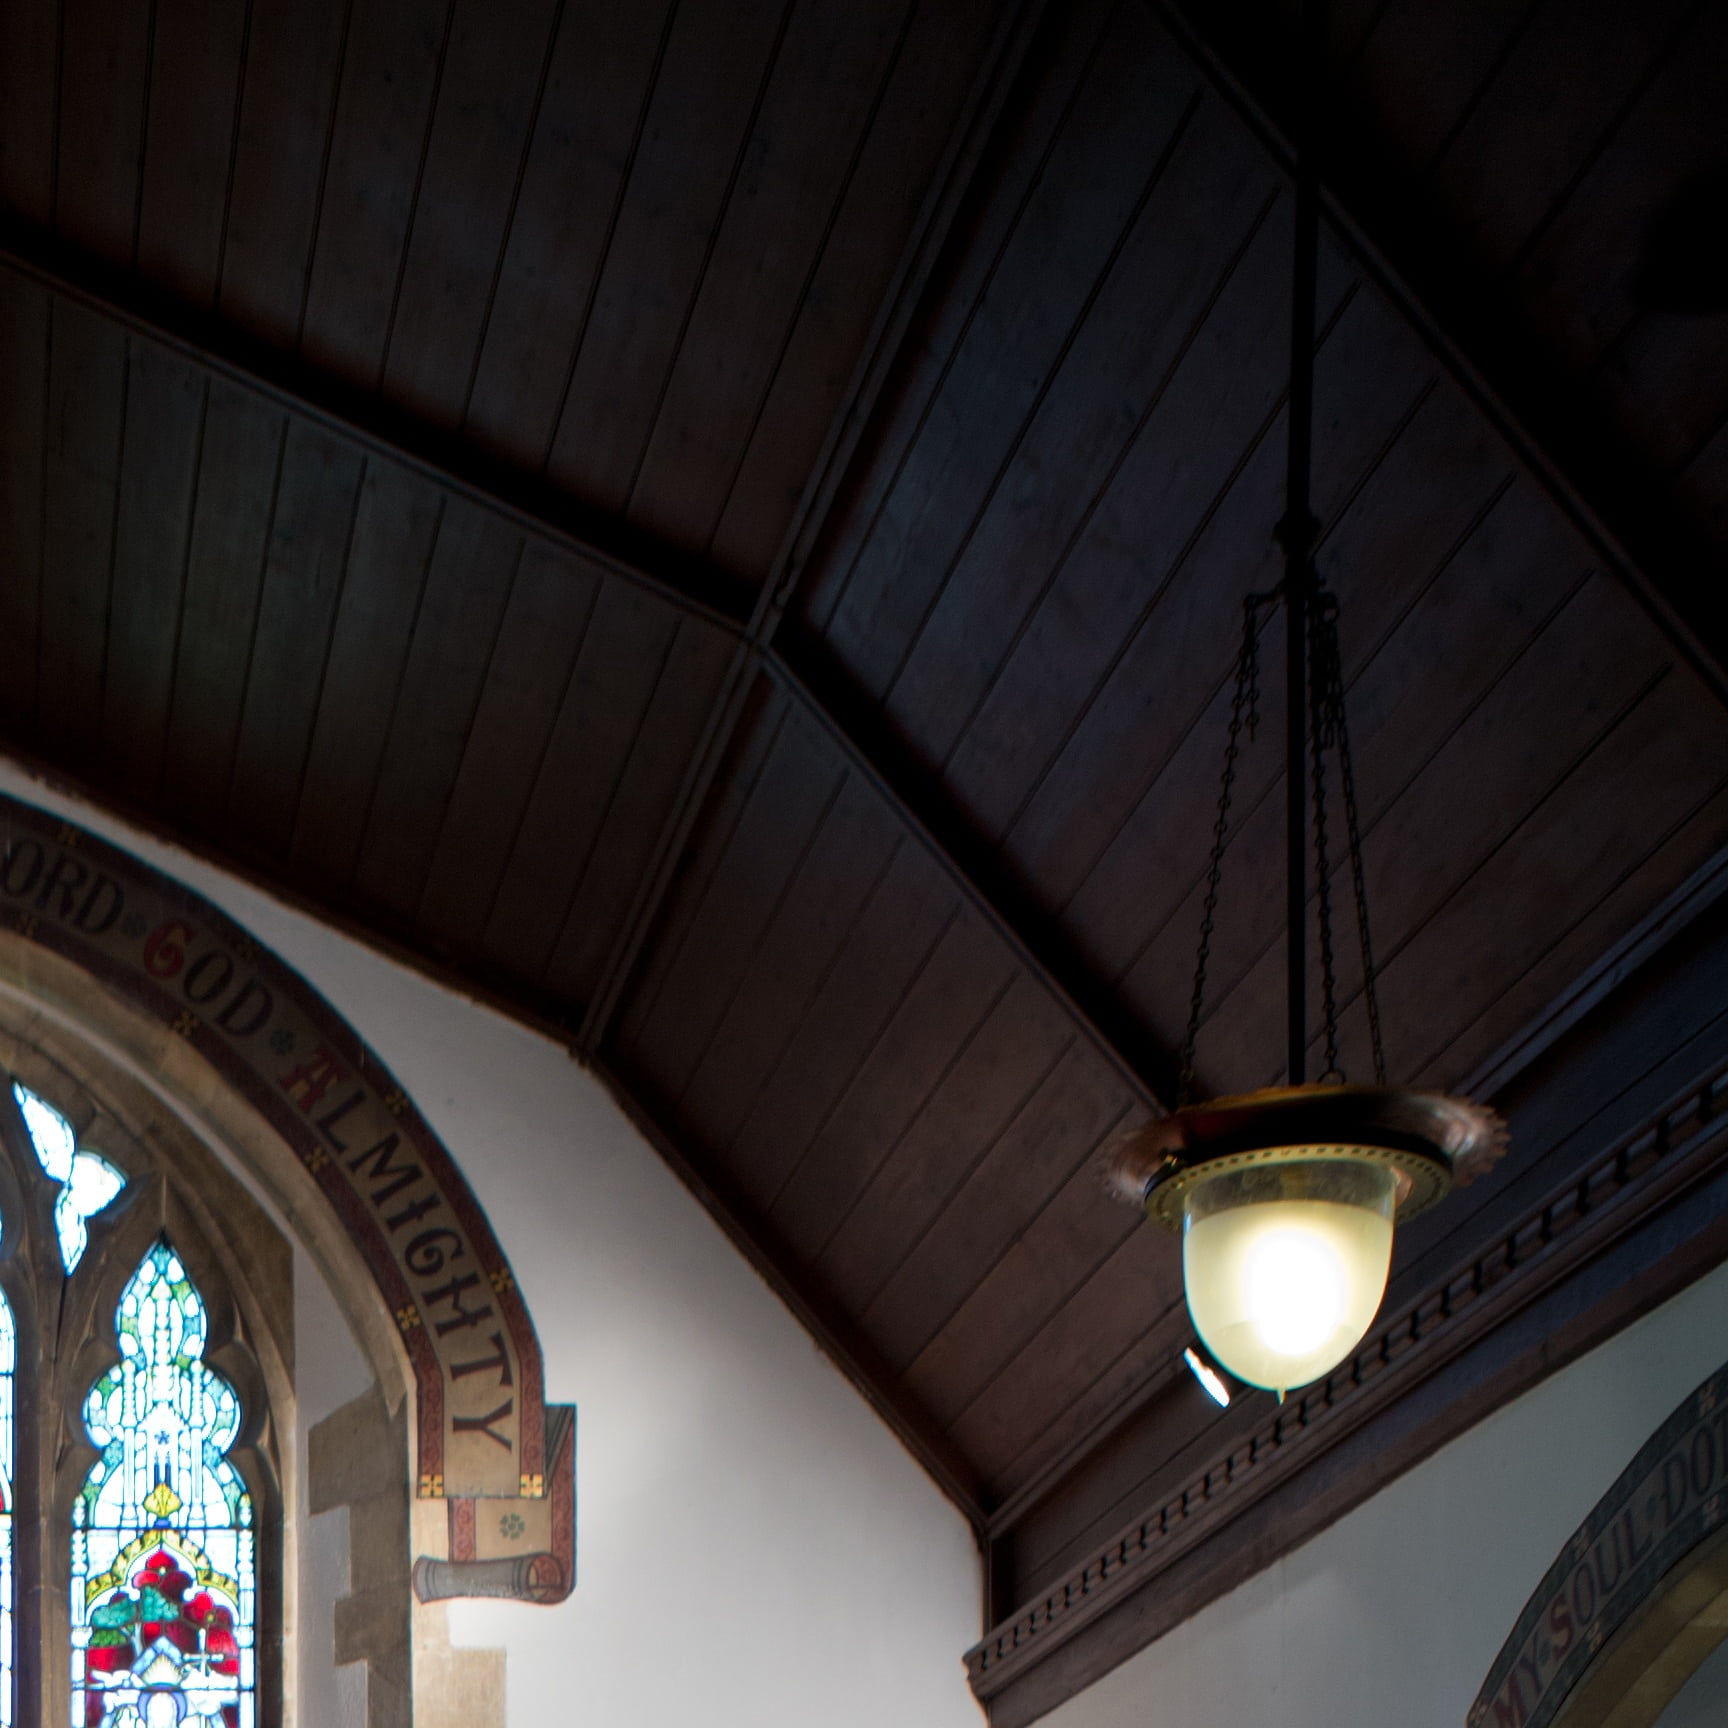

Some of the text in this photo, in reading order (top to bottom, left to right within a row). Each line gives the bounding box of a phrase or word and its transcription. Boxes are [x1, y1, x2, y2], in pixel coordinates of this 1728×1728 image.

[143, 919, 274, 1036] GOD
[278, 1043, 514, 1455] ALMIGHTY
[1548, 1508, 1654, 1661] SOUL
